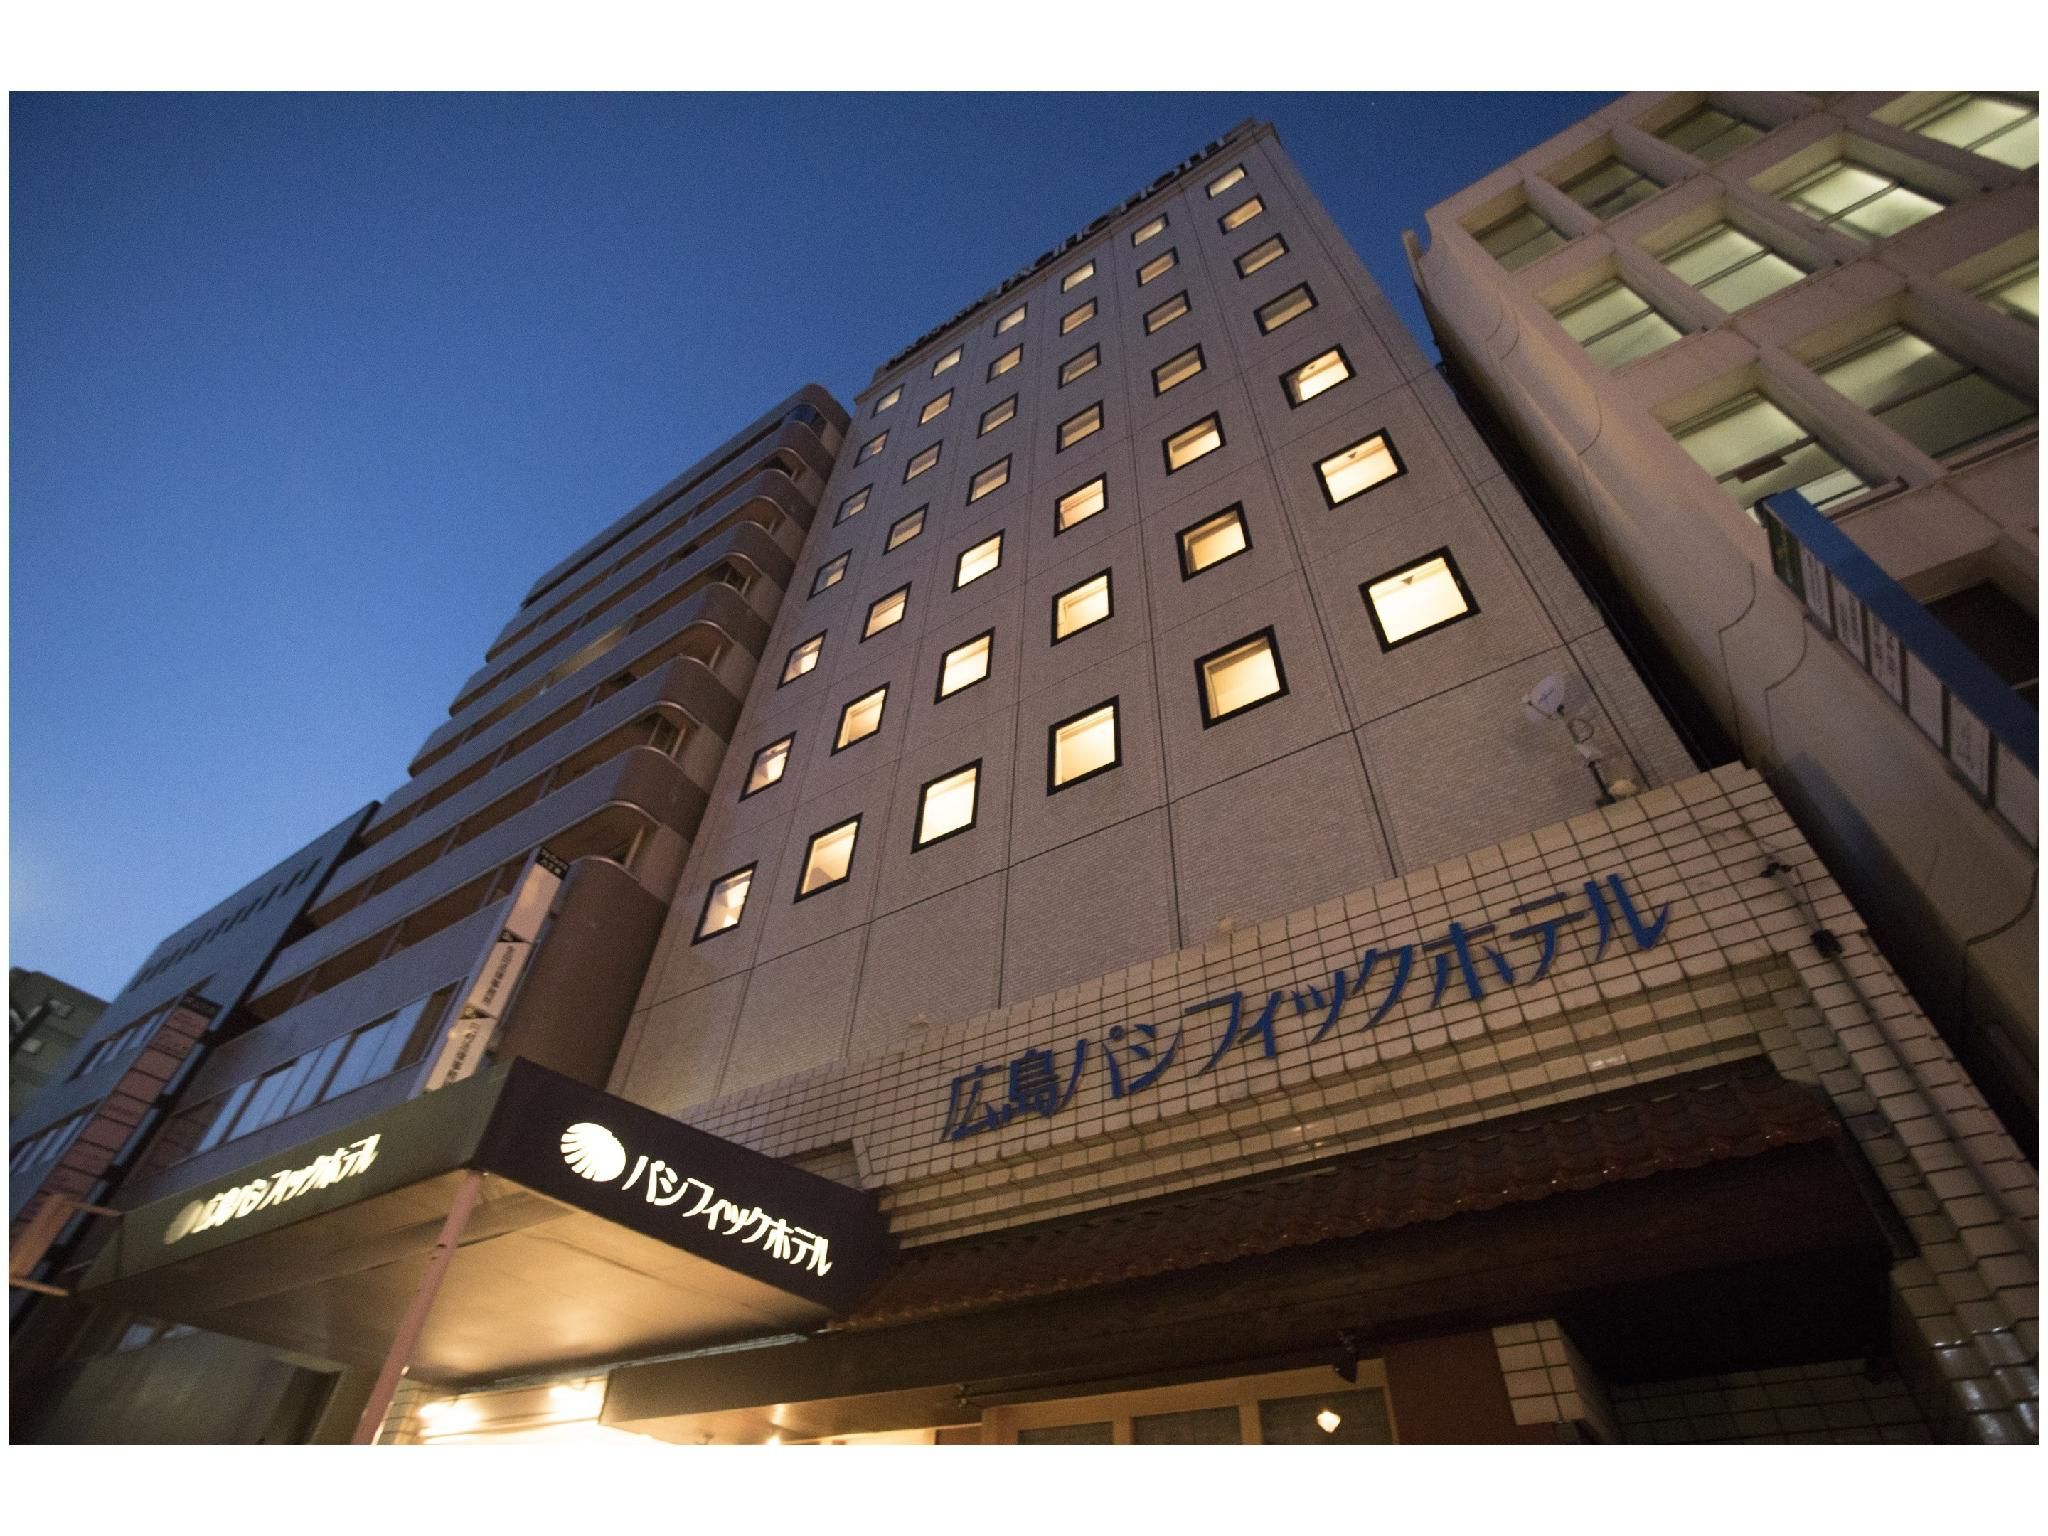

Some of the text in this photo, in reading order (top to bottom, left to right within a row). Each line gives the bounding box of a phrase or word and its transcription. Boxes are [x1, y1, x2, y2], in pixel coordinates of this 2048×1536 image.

[940, 873, 1670, 1142] 広島パシフィックホテル
[621, 1155, 833, 1277] パシフィックホテル
